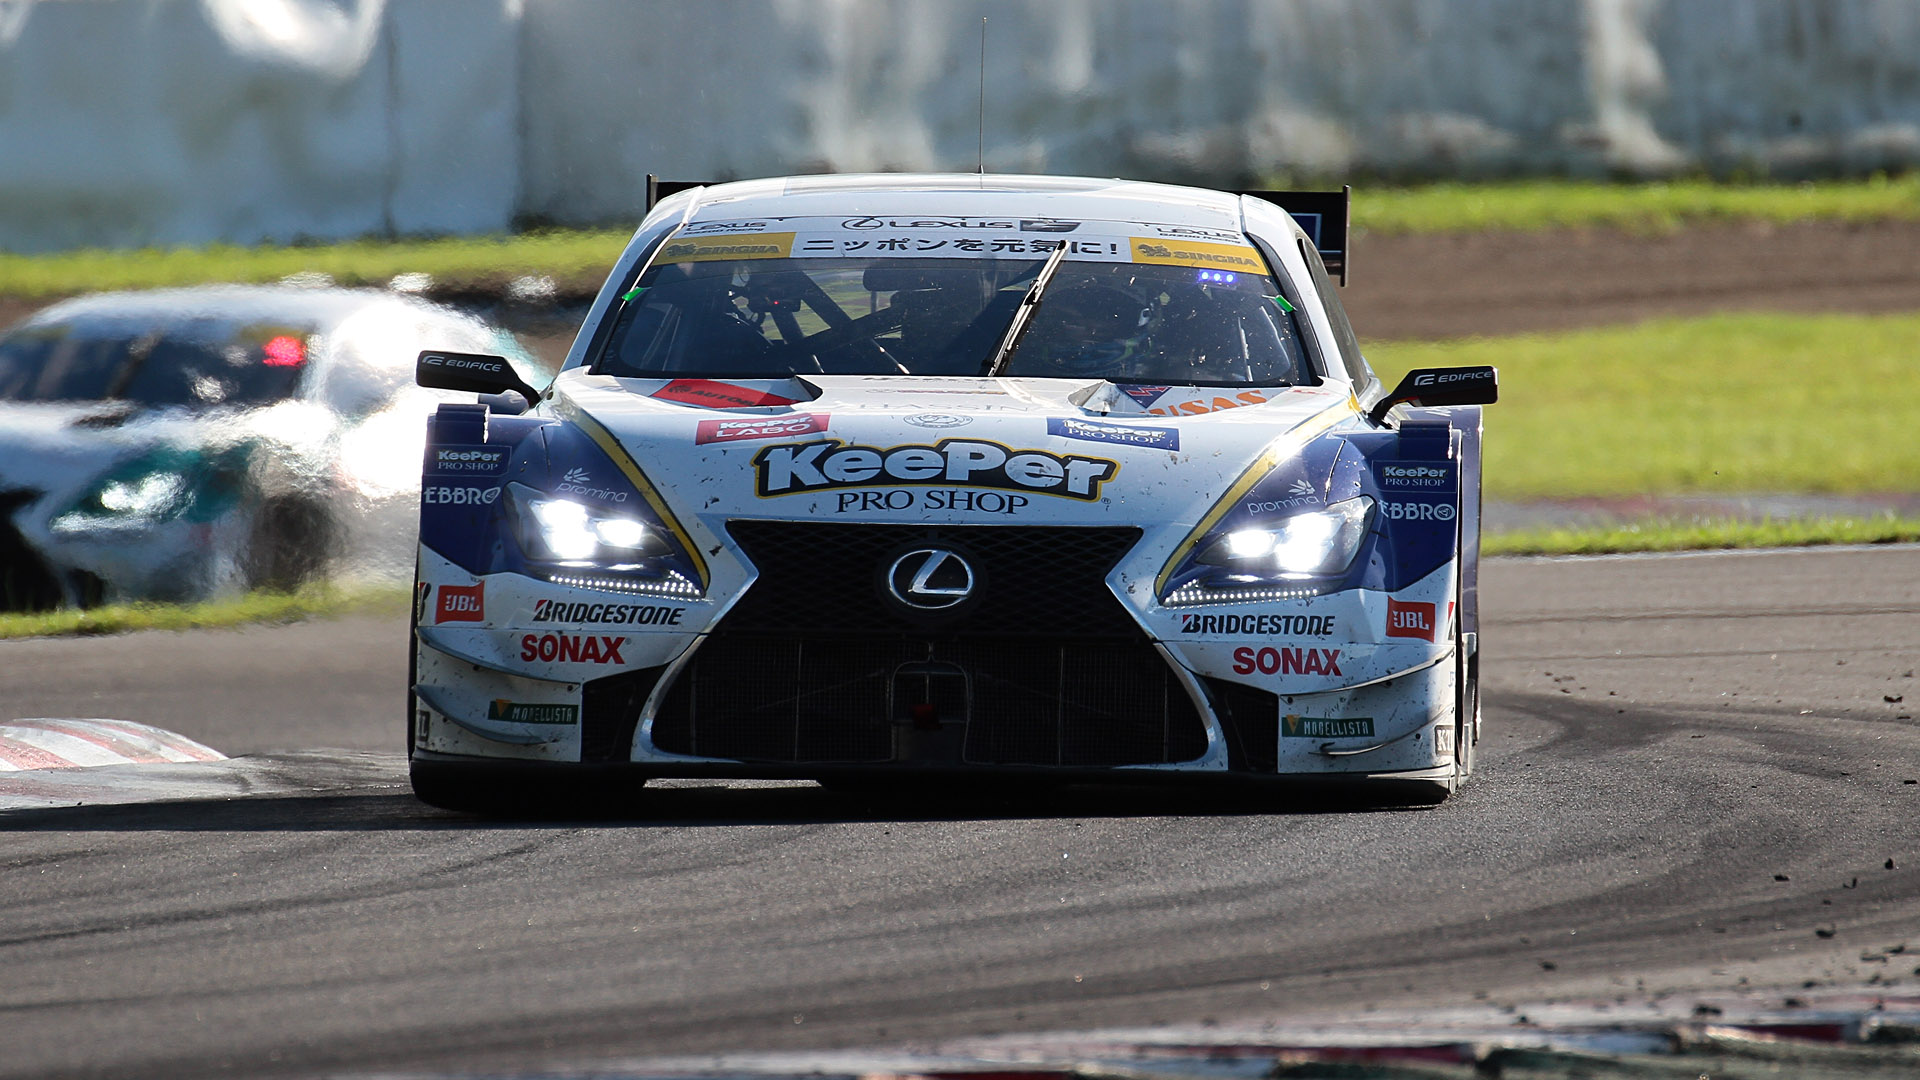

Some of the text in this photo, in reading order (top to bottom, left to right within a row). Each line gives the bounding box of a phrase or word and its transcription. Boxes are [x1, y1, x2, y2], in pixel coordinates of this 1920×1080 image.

[686, 222, 767, 232] LEXUS
[890, 219, 1014, 229] LEXUS
[1157, 228, 1239, 240] LEXUS
[696, 245, 780, 255] SINGHA
[1173, 251, 1259, 268] SINGHA
[446, 359, 502, 372] EDIFICE
[1437, 371, 1493, 383] EDIFICE
[716, 424, 810, 437] LABO
[719, 417, 812, 430] KeePer
[1063, 420, 1166, 438] KeePer
[1069, 428, 1161, 444] PRO SHOP
[438, 450, 500, 461] KeePer
[438, 462, 499, 471] PRO SHOP
[762, 442, 1109, 495] KeePer
[1384, 467, 1447, 478] KeePer
[1385, 479, 1445, 487] PRO SHOP
[556, 482, 628, 503] promina
[836, 490, 1029, 514] PRO SHOP
[1247, 496, 1320, 517] promina
[445, 594, 480, 611] JBL
[533, 599, 687, 625] BRIDGESTONE
[1181, 614, 1336, 635] BRIDGESTONE
[1393, 611, 1430, 631] JBL
[520, 634, 626, 664] SONAX
[1232, 646, 1342, 677] SONAX
